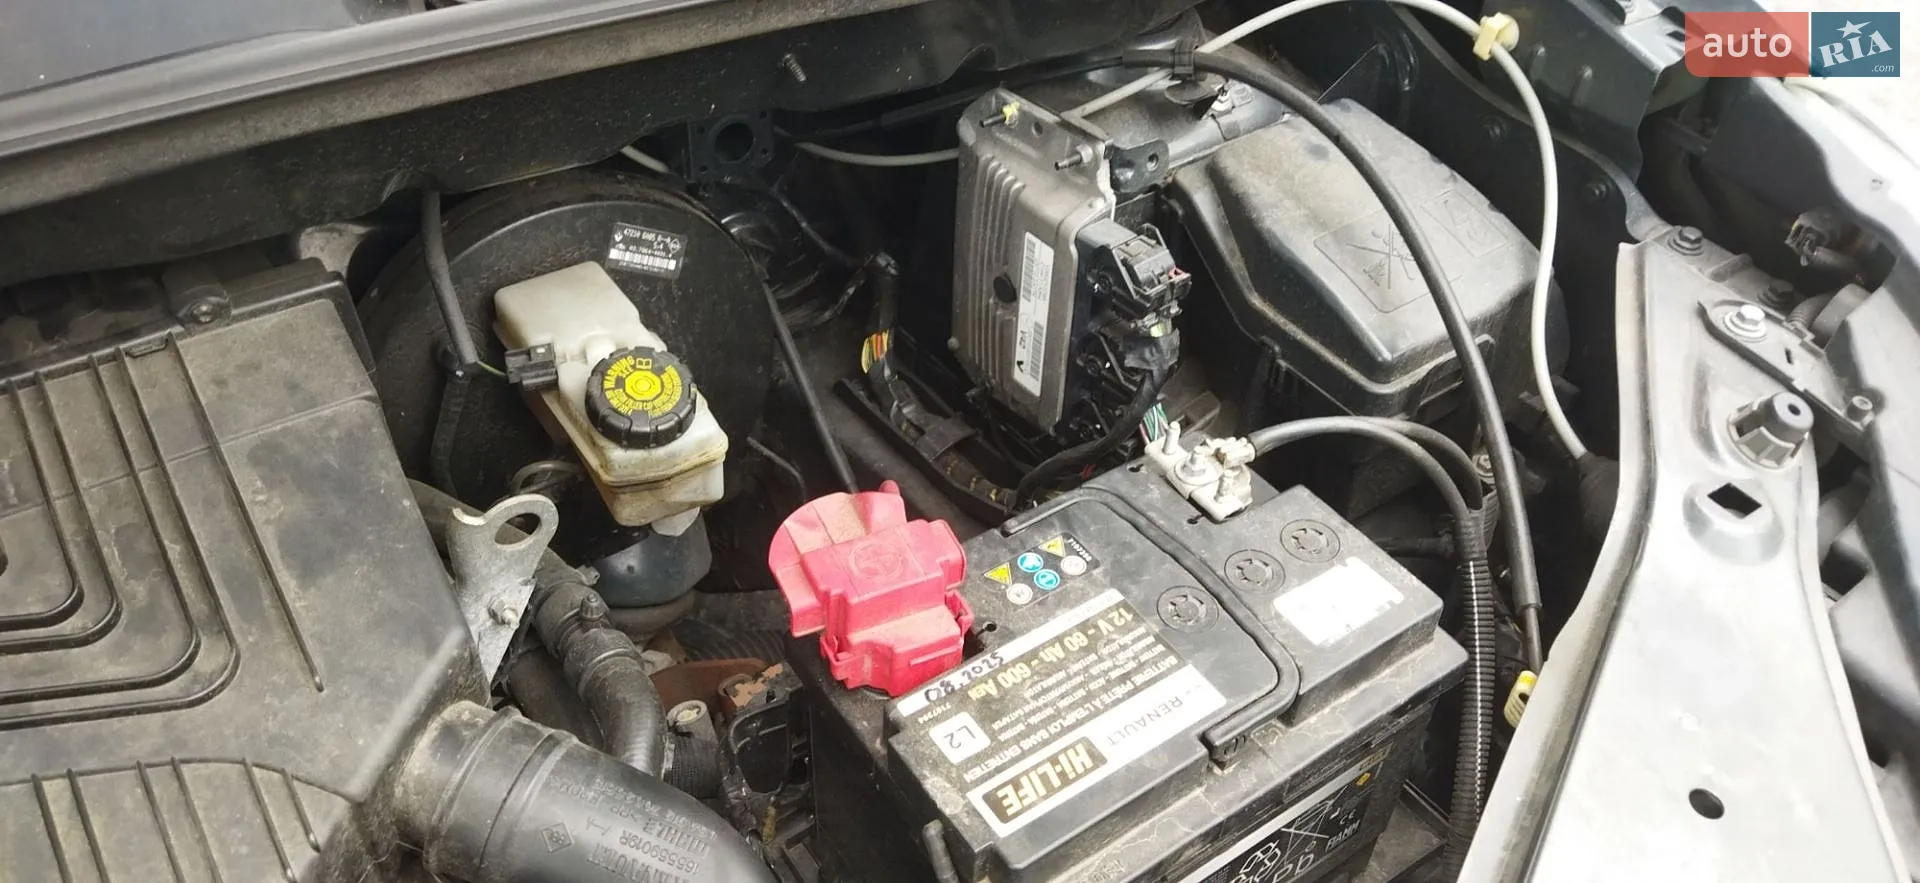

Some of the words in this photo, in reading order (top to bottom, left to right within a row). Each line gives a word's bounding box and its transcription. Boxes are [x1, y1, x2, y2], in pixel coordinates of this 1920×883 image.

[1093, 617, 1113, 633] V
[1108, 606, 1134, 625] 12
[1038, 642, 1068, 664] Ah
[1062, 630, 1089, 651] 60
[995, 662, 1033, 688] 600
[1104, 695, 1184, 746] RENAULT
[943, 724, 976, 750] L2
[992, 743, 1097, 815] Hi-LIFE
[1325, 819, 1361, 852] FIAMM
[618, 829, 700, 876] 165559019R
